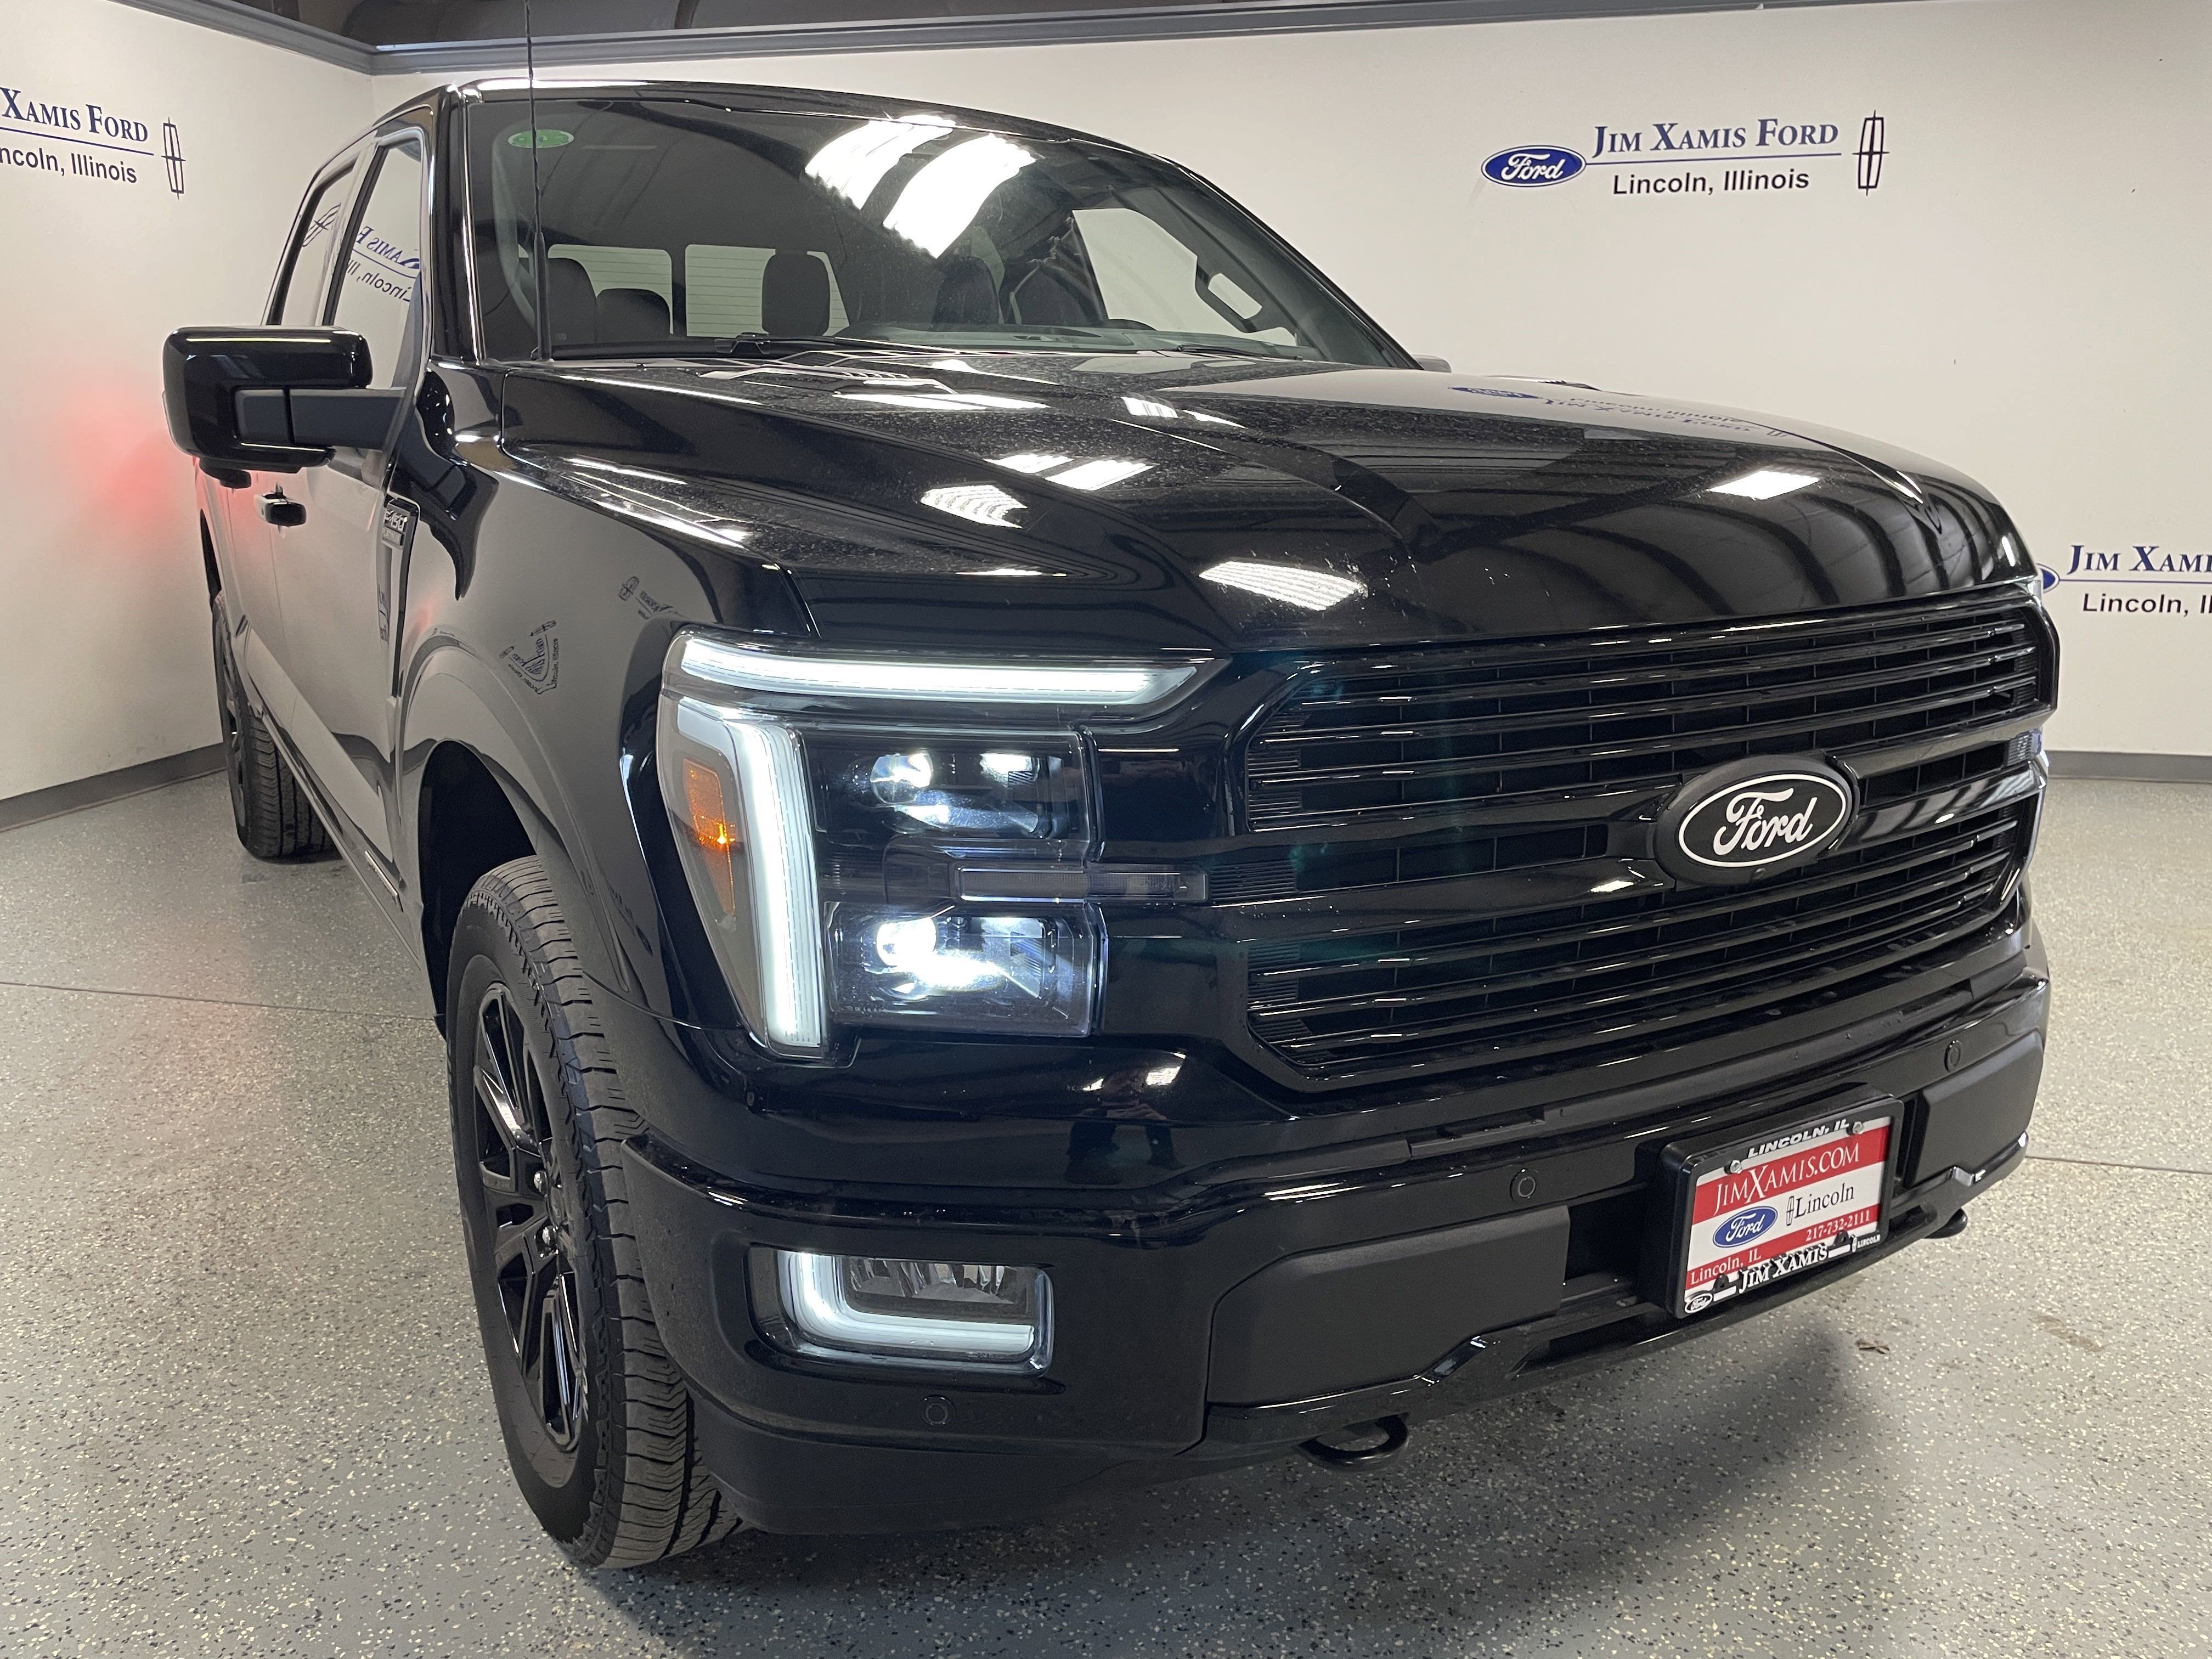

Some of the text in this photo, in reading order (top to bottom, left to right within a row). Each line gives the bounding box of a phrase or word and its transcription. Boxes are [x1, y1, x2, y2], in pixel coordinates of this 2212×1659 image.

[0, 87, 148, 142] XAMIS FORD
[1592, 118, 1838, 159] JIM XAMIS FORD
[0, 147, 137, 184] ncoln, Illinois
[1500, 153, 1566, 180] Ford
[1613, 168, 1809, 195] Lincoln, Illinois
[2066, 545, 2212, 575] JIM XAMI
[2083, 592, 2188, 618] Lincoln,
[1713, 787, 1818, 856] Ford
[1747, 1118, 1850, 1159] LINCOLN, IL
[1713, 1142, 1860, 1216] JIMXAMIS.COM
[1793, 1182, 1855, 1220] Lincoln
[1725, 1213, 1765, 1242] Ford
[1805, 1209, 1870, 1242] 217-732-2111
[1690, 1248, 1762, 1285] Lincoln, IL
[1738, 1244, 1828, 1294] JIM XAMIS
